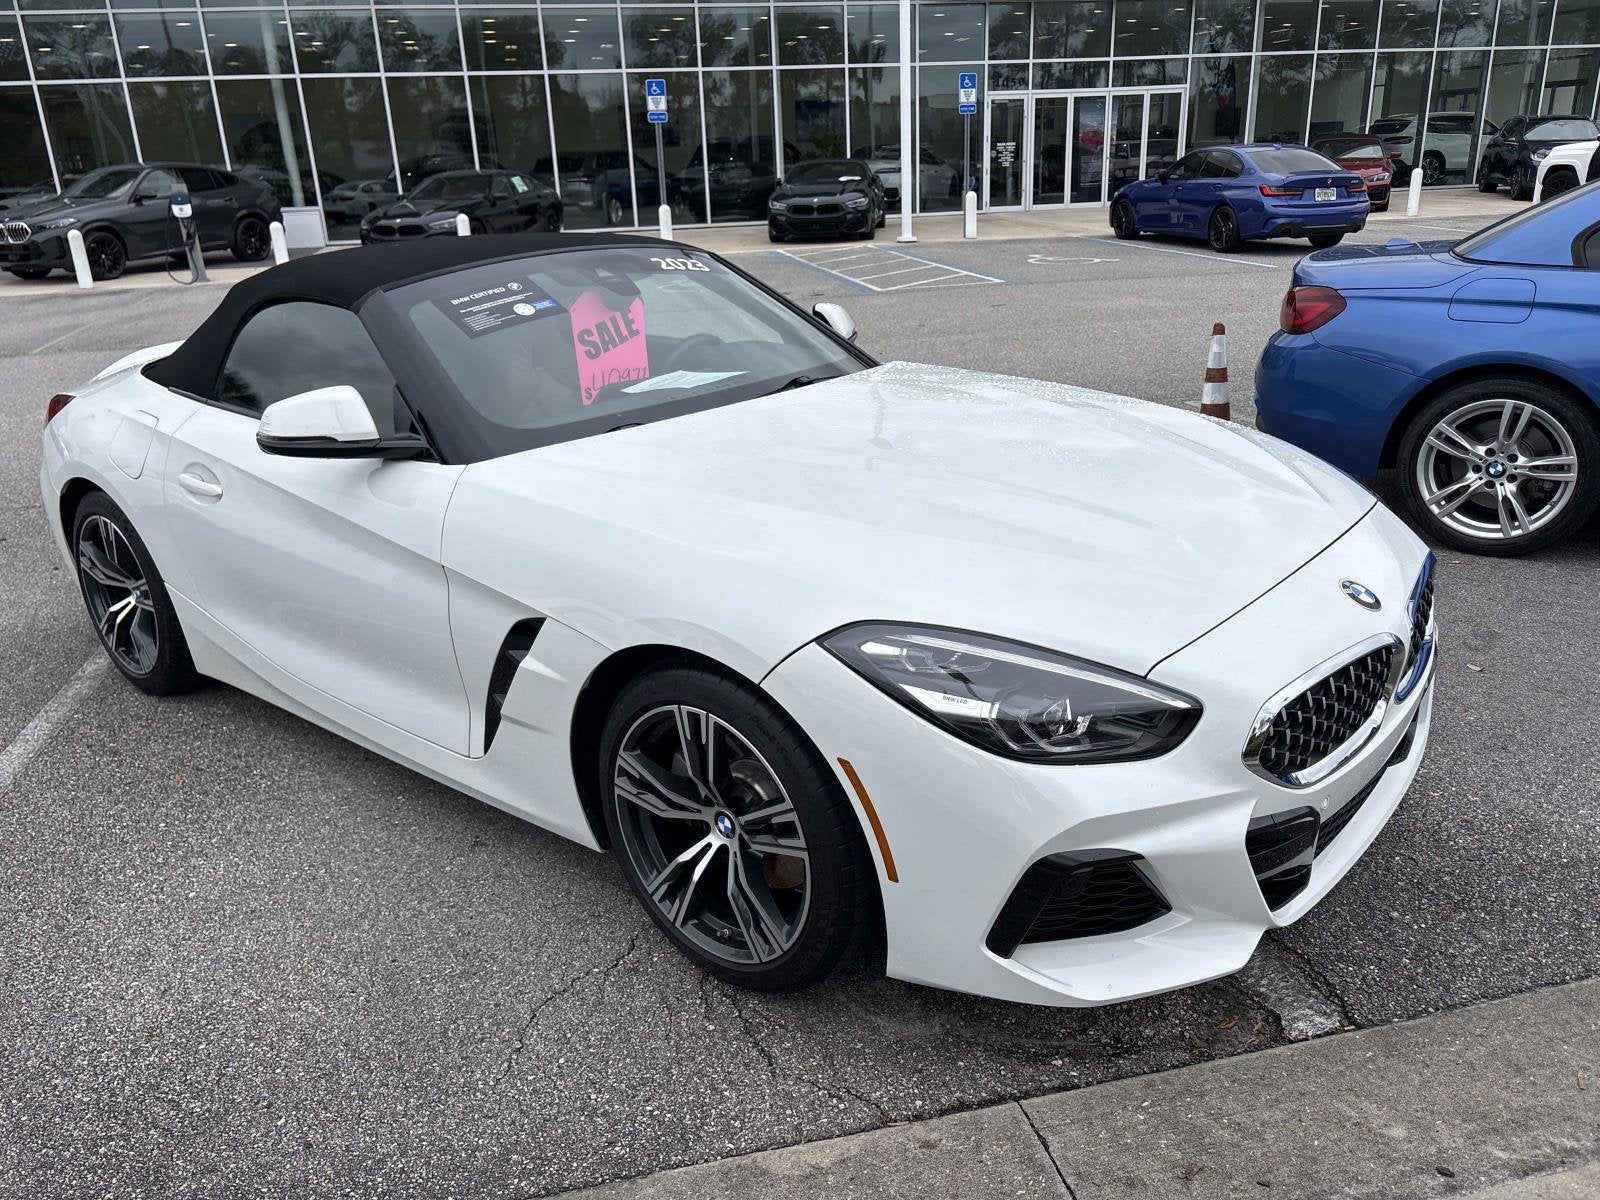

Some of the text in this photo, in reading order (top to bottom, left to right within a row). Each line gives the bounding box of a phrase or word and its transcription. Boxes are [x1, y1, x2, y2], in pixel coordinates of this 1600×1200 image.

[650, 257, 710, 271] 2023
[450, 296, 470, 305] BMW
[470, 287, 506, 300] CERTIFIED
[577, 304, 641, 360] SALE
